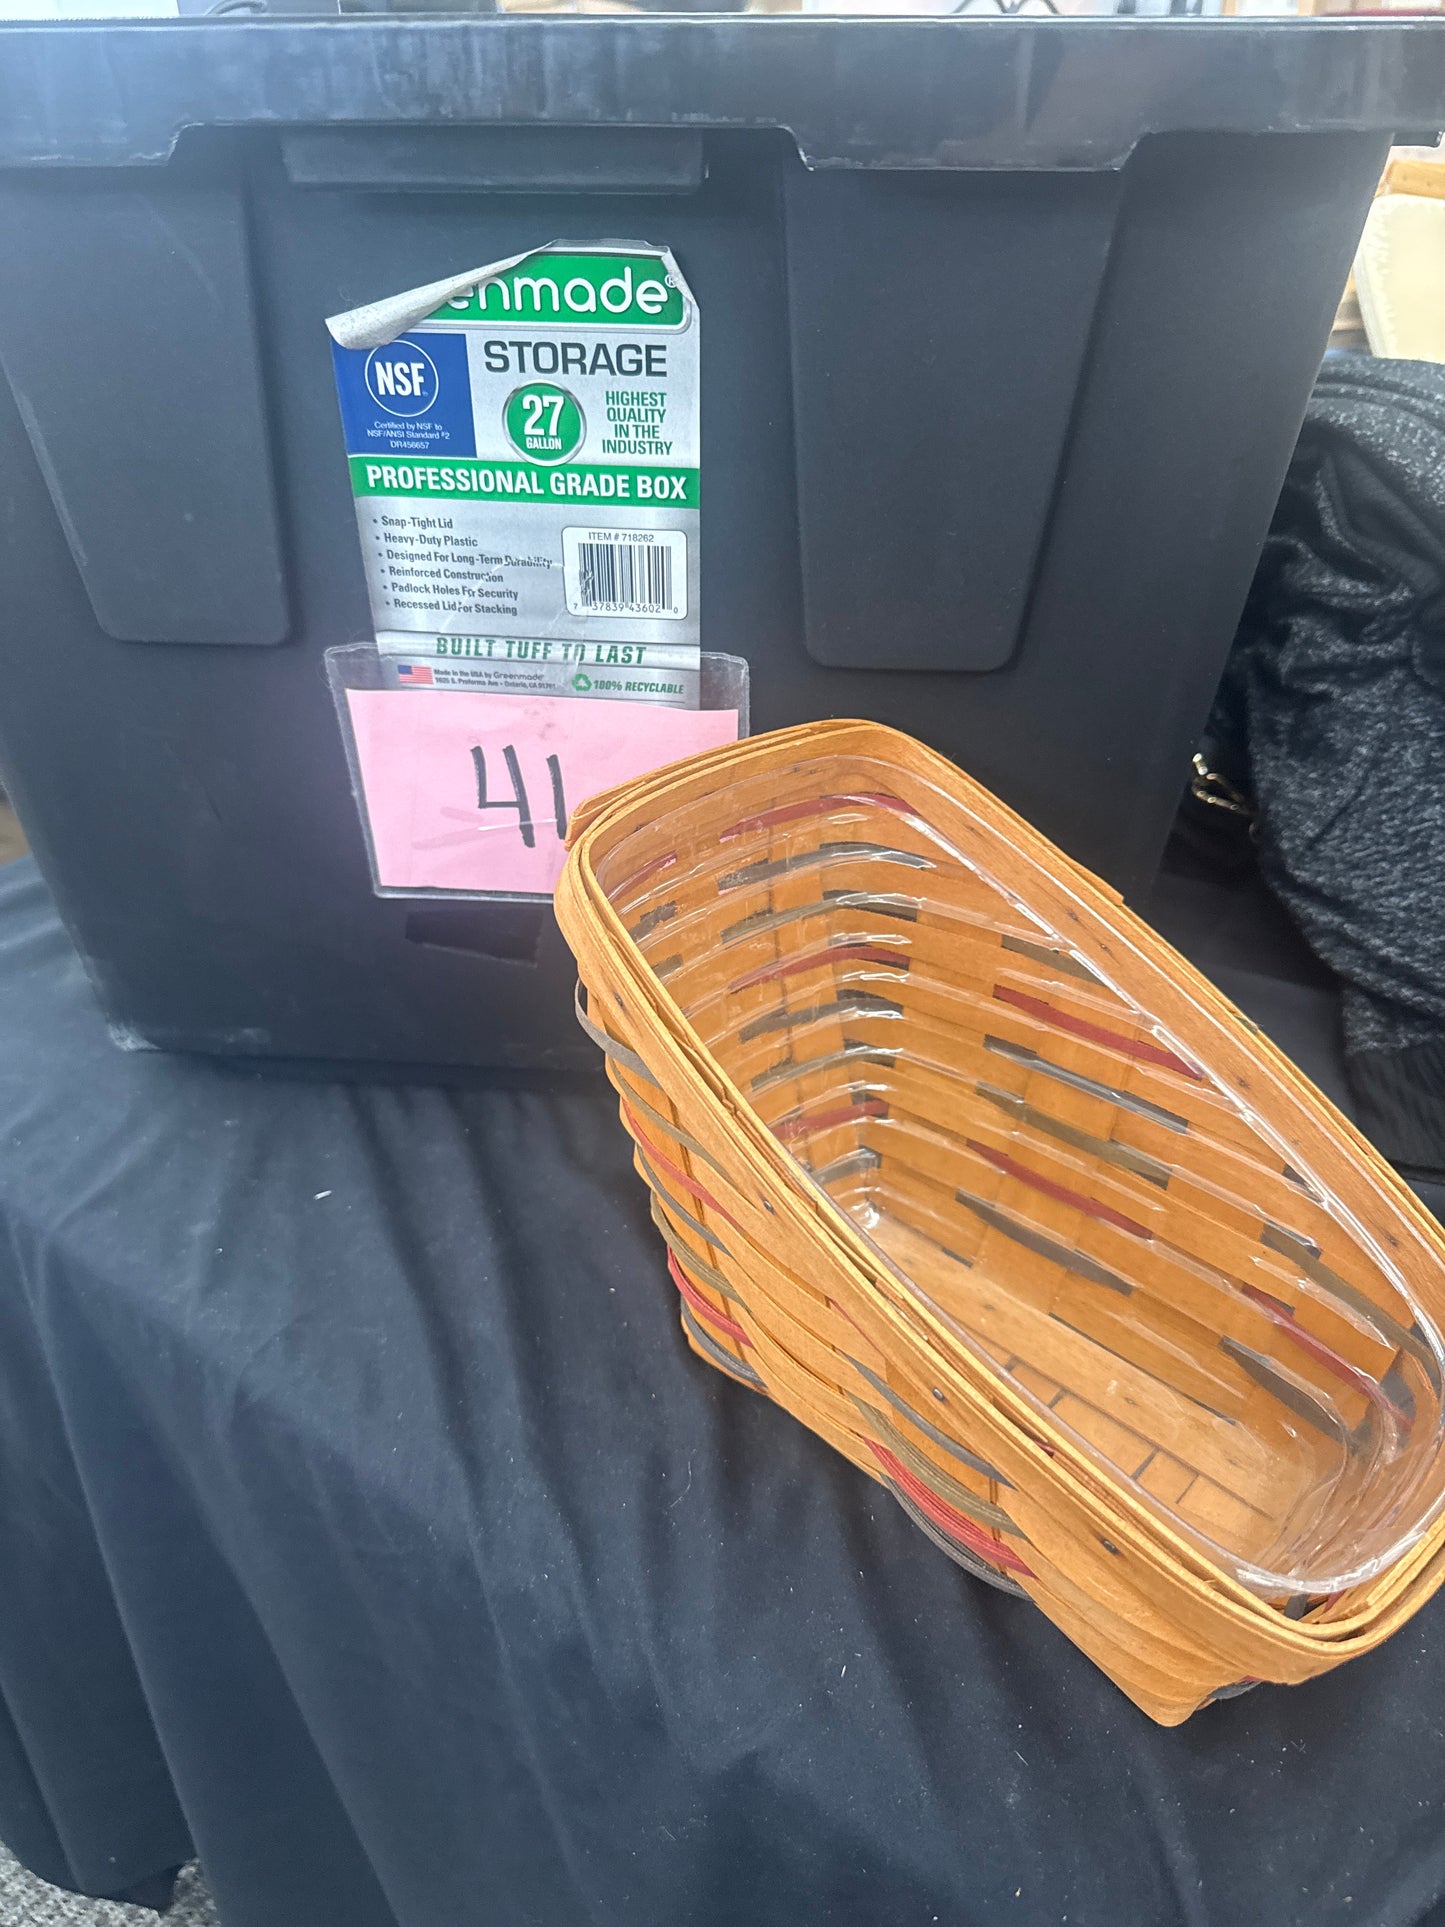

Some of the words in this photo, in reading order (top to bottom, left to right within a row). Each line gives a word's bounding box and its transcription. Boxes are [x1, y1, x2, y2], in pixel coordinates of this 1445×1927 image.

[484, 340, 667, 378] STORAGE
[375, 361, 424, 396] NSF
[605, 391, 667, 407] HIGHEST
[522, 395, 564, 436] 27
[606, 408, 667, 424] QUALITY
[366, 429, 405, 438] NSF/ANSI
[406, 430, 440, 439] Standard
[374, 421, 405, 430] Certified
[406, 422, 415, 431] by
[416, 422, 433, 430] NSF
[434, 423, 443, 431] to
[614, 424, 630, 438] IN
[633, 424, 660, 439] THE
[526, 437, 562, 450] GALLON
[602, 440, 673, 456] INDUSTRY
[365, 463, 545, 495] PROFESSIONAL
[550, 471, 631, 498] GRADE
[637, 475, 687, 500] BOX
[381, 515, 437, 530] Snap-Tight
[438, 518, 453, 529] Lid
[384, 532, 442, 547] Heavy-Duty
[444, 535, 478, 547] Plastic
[588, 532, 612, 541] ITEM
[621, 533, 655, 543] 718262
[386, 550, 432, 564] Designed
[434, 552, 449, 562] For
[451, 552, 503, 566] Long-Term
[389, 566, 441, 579] Reinforced
[443, 569, 504, 583] Construction
[391, 582, 431, 594] Padlock
[432, 585, 460, 596] Holes
[462, 587, 476, 598] For
[478, 588, 519, 601] Security
[394, 598, 440, 611] Recessed
[442, 601, 456, 611] Lid
[475, 604, 518, 616] Stacking
[592, 602, 625, 612] 37839
[629, 604, 661, 614] 43602
[436, 637, 496, 657] BUILT
[506, 640, 553, 660] TUFF
[562, 643, 586, 662] TO
[595, 644, 647, 665] LAST
[593, 680, 623, 691] 100%
[625, 681, 684, 694] RECYCLABLE
[470, 744, 567, 848] 41
